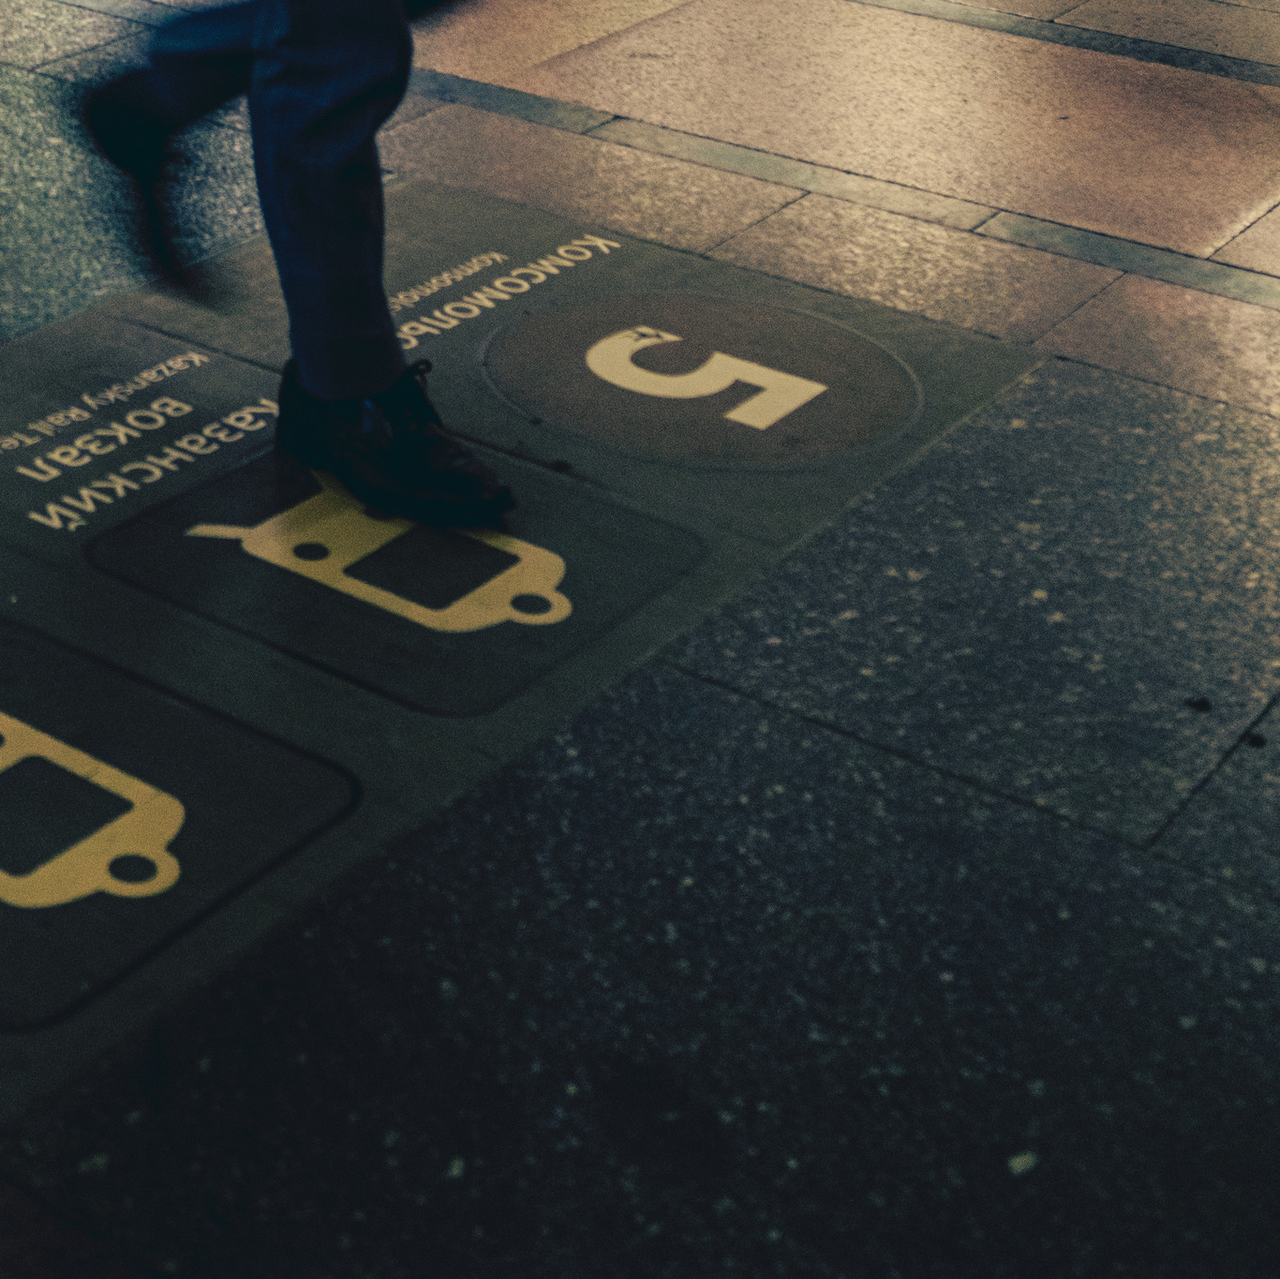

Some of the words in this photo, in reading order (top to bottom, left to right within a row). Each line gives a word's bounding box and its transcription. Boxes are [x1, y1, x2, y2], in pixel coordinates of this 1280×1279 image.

[395, 232, 621, 349] Комсомольс
[26, 405, 90, 436] Rail
[80, 350, 209, 409] Kazansky
[584, 324, 829, 430] 5
[14, 395, 192, 482] вокзал
